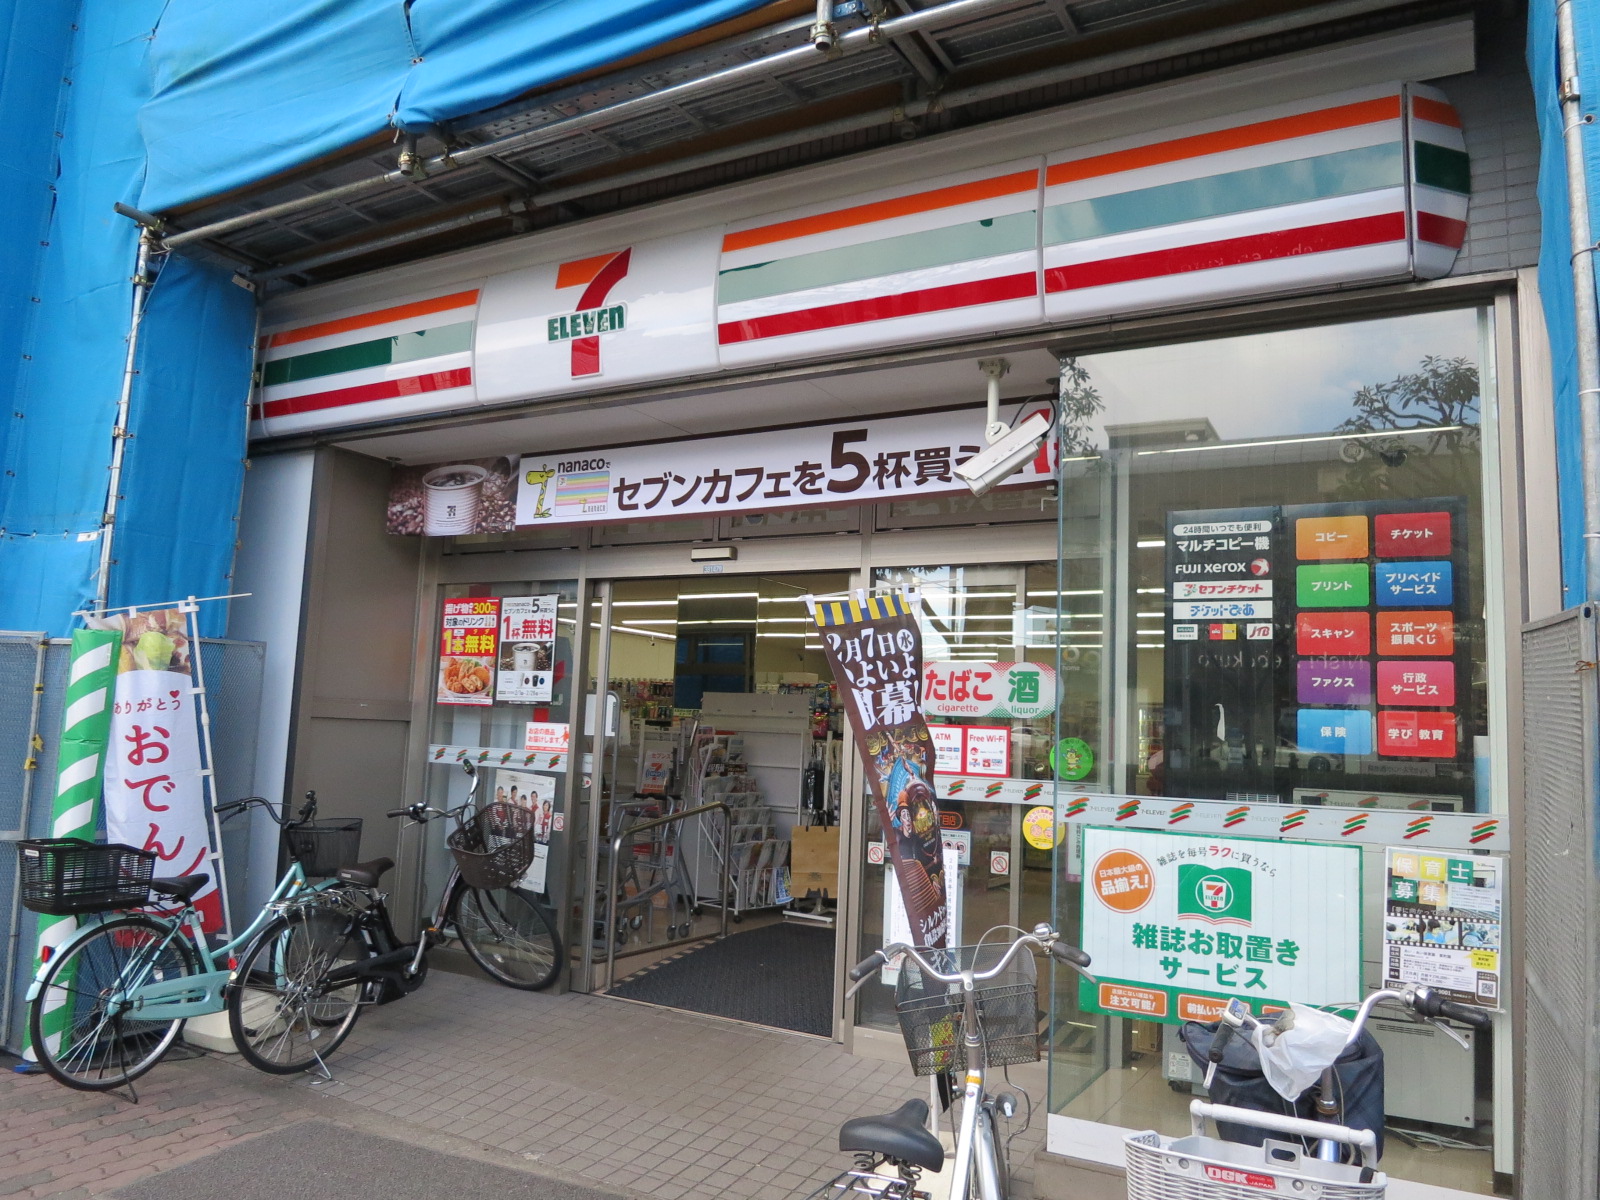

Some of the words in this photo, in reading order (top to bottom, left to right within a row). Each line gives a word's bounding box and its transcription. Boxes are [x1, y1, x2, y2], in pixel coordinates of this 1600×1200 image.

[555, 246, 632, 376] 7
[1183, 523, 1262, 534] 24時間いつでも便利
[1391, 528, 1434, 540] チケット
[1315, 532, 1349, 542] コピー
[1176, 536, 1270, 552] マルチコピー機
[1175, 564, 1201, 574] FUJI
[1204, 562, 1247, 573] xerox
[1386, 572, 1441, 583] プリペイド
[1198, 584, 1263, 595] セブンチケット
[1311, 581, 1353, 591] プリント
[1390, 584, 1437, 595] サービス
[1190, 603, 1255, 617] チケットぴあ
[1249, 626, 1270, 638] JTB
[1311, 628, 1354, 639] スキャン
[1390, 622, 1438, 633] スポーツ
[1391, 634, 1437, 645] 振興くじ
[1311, 677, 1355, 687] ファクス
[1403, 672, 1427, 683] 行政
[925, 668, 994, 702] たばこ
[1008, 670, 1039, 703] 酒
[1391, 684, 1439, 695] サービス
[114, 697, 181, 715] ありがとう
[937, 704, 979, 713] cigarette
[1011, 705, 1040, 715] liquor
[935, 733, 951, 741] ATM
[1320, 726, 1347, 738] 保険
[1388, 728, 1413, 740] 学び
[1418, 729, 1444, 741] 教育
[969, 734, 985, 742] Free
[986, 735, 1006, 743] Wi-Fi
[124, 724, 186, 862] おでん
[1156, 845, 1277, 878] 雑誌を毎号ラクに買うなら
[1396, 856, 1470, 880] 保育士
[1101, 874, 1149, 895] 品揃え!
[1395, 881, 1441, 902] 募集
[1132, 922, 1300, 967] 雑誌お取置き
[1160, 956, 1268, 990] サービス
[1110, 995, 1156, 1011] 注文可能!
[1187, 1003, 1227, 1018] 前払い不
[1207, 1167, 1248, 1185] OGK
[1249, 1181, 1274, 1189] JAPAN
